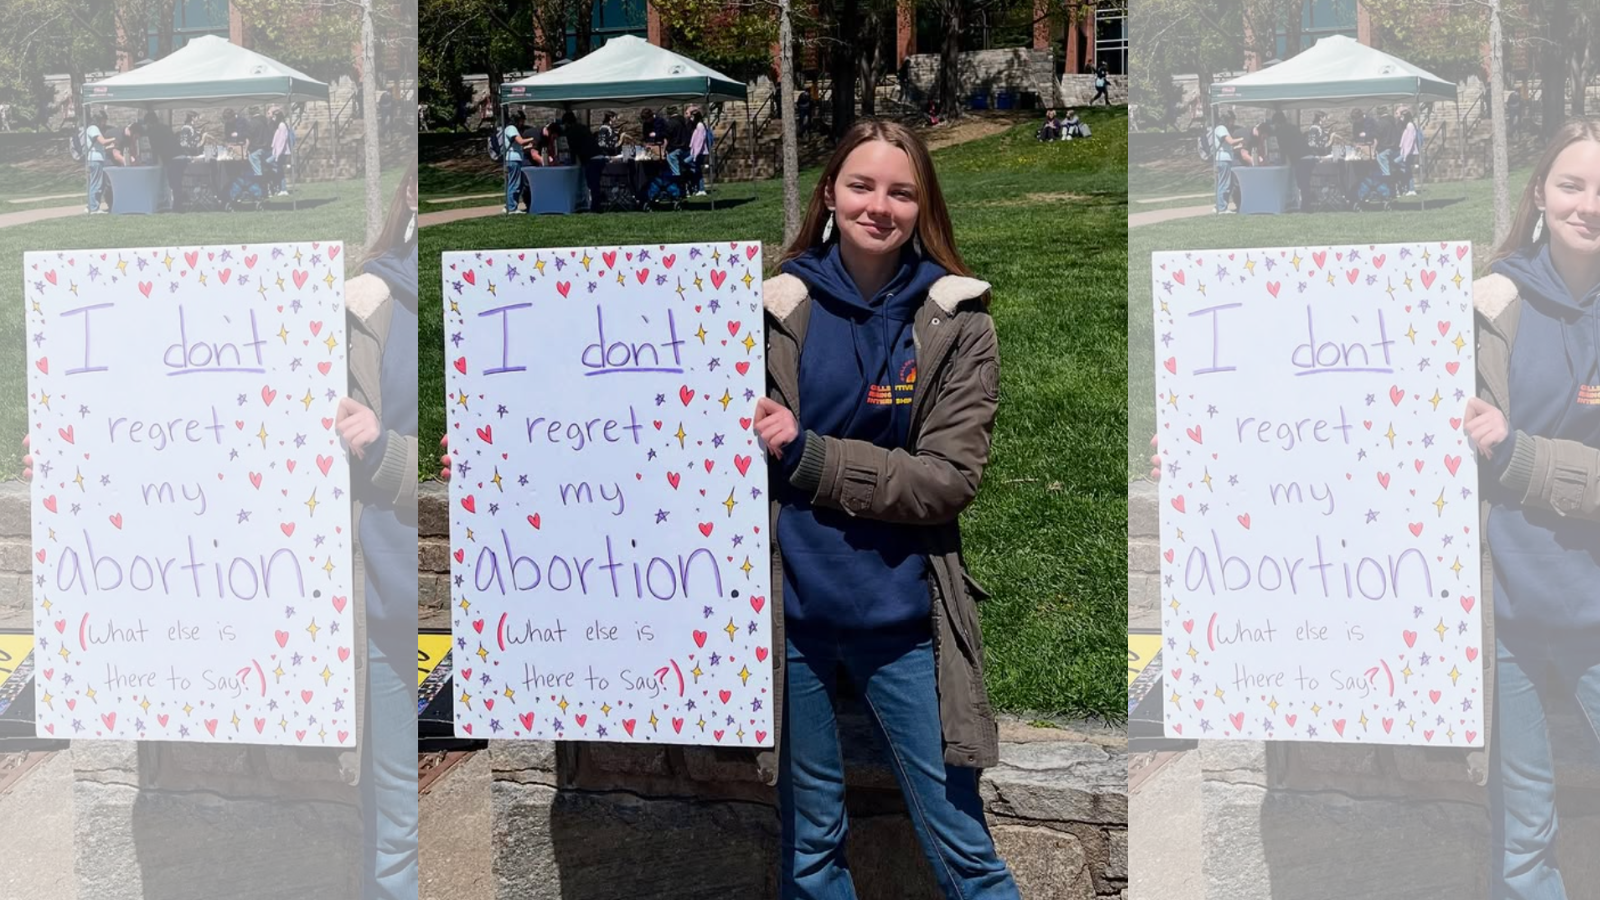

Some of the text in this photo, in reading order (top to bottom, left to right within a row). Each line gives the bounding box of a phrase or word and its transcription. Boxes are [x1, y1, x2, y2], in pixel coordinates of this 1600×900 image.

[60, 302, 114, 375] I
[478, 302, 532, 375] I
[1188, 302, 1242, 375] I
[108, 405, 225, 450] regret
[526, 405, 643, 450] regret
[1236, 405, 1353, 450] regret
[141, 481, 207, 516] my
[559, 481, 625, 516] my
[1269, 481, 1335, 516] my
[57, 528, 321, 601] abortion.
[475, 528, 739, 601] abortion.
[1185, 528, 1449, 601] abortion.
[167, 620, 200, 641] else
[217, 621, 237, 641] is
[585, 620, 618, 641] else
[635, 621, 655, 641] is
[1295, 620, 1328, 641] else
[1345, 621, 1365, 641] is
[104, 662, 156, 692] there
[167, 665, 191, 691] to
[522, 662, 574, 692] there
[585, 665, 609, 691] to
[1232, 662, 1284, 692] there
[1295, 665, 1319, 691] to
